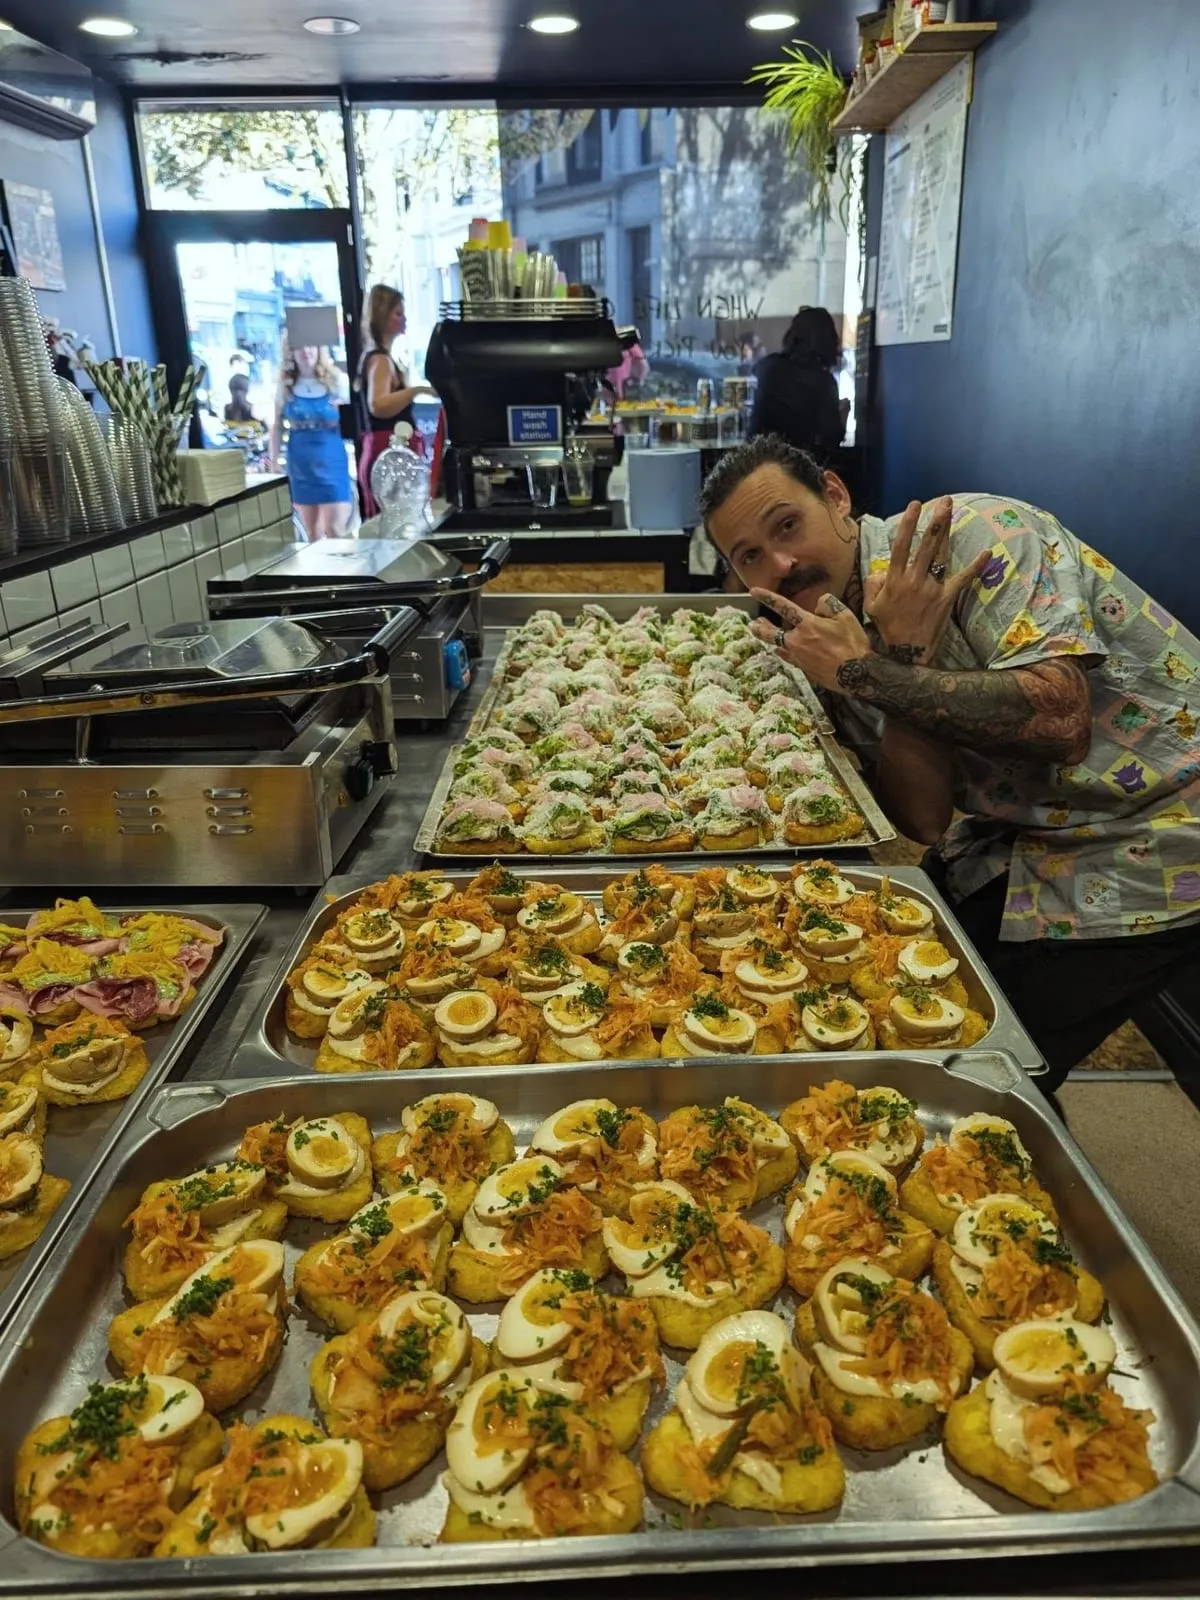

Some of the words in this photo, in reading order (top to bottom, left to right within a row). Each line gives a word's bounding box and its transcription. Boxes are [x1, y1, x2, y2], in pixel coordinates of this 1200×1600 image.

[521, 410, 548, 420] Hand
[522, 421, 548, 430] wash
[520, 431, 552, 441] station
